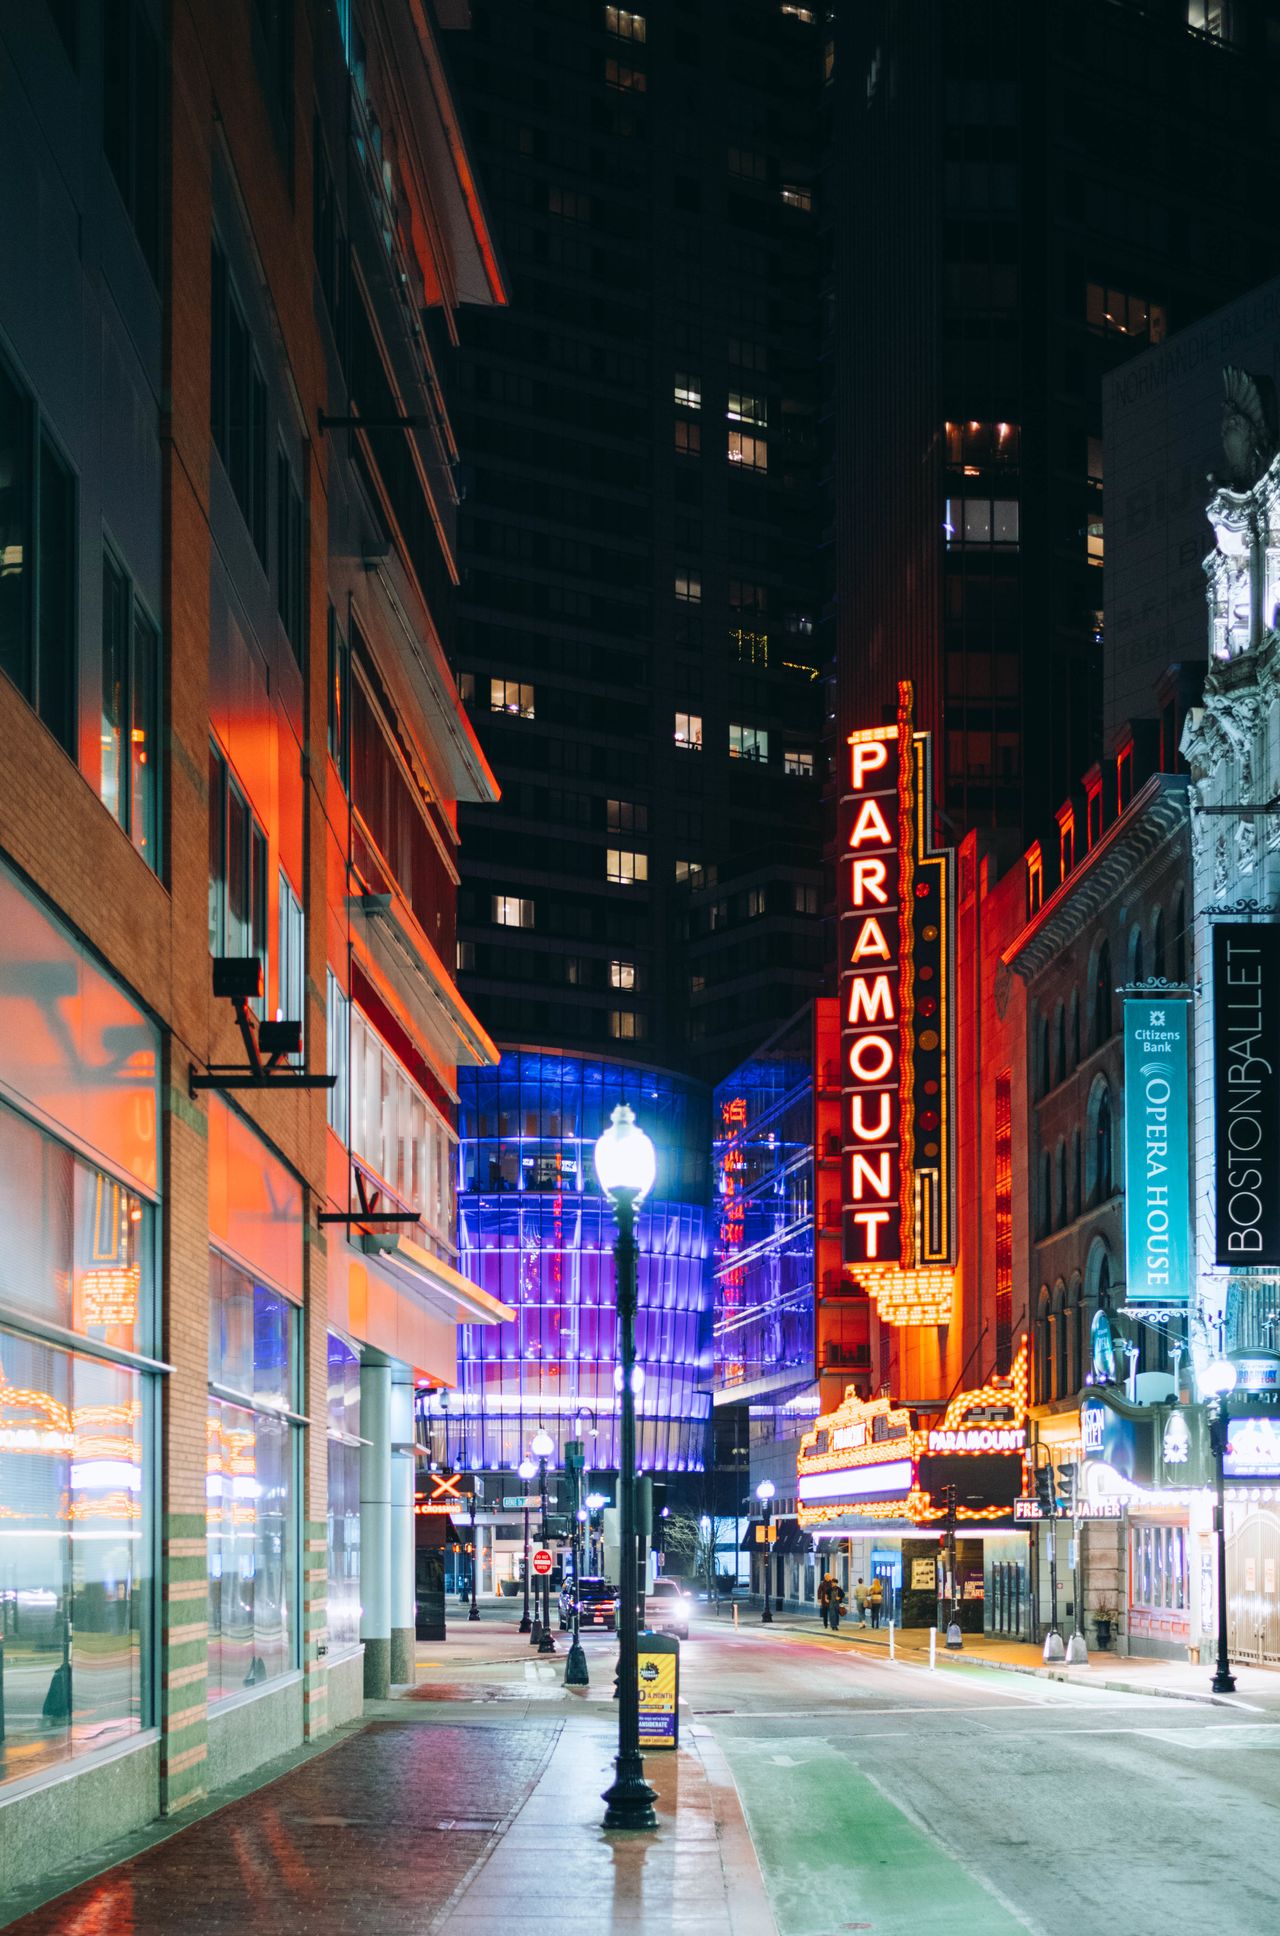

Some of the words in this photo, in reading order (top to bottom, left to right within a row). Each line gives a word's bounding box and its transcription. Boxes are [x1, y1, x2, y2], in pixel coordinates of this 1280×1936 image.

[848, 741, 894, 1259] PARAMOUNT
[1134, 1029, 1180, 1041] Citizens
[1143, 1041, 1172, 1053] Bank
[1145, 1078, 1171, 1180] OPERA
[1146, 1186, 1169, 1286] HOUSE
[929, 1430, 1026, 1450] PARAMOUNT
[421, 1504, 463, 1515] CROSSING
